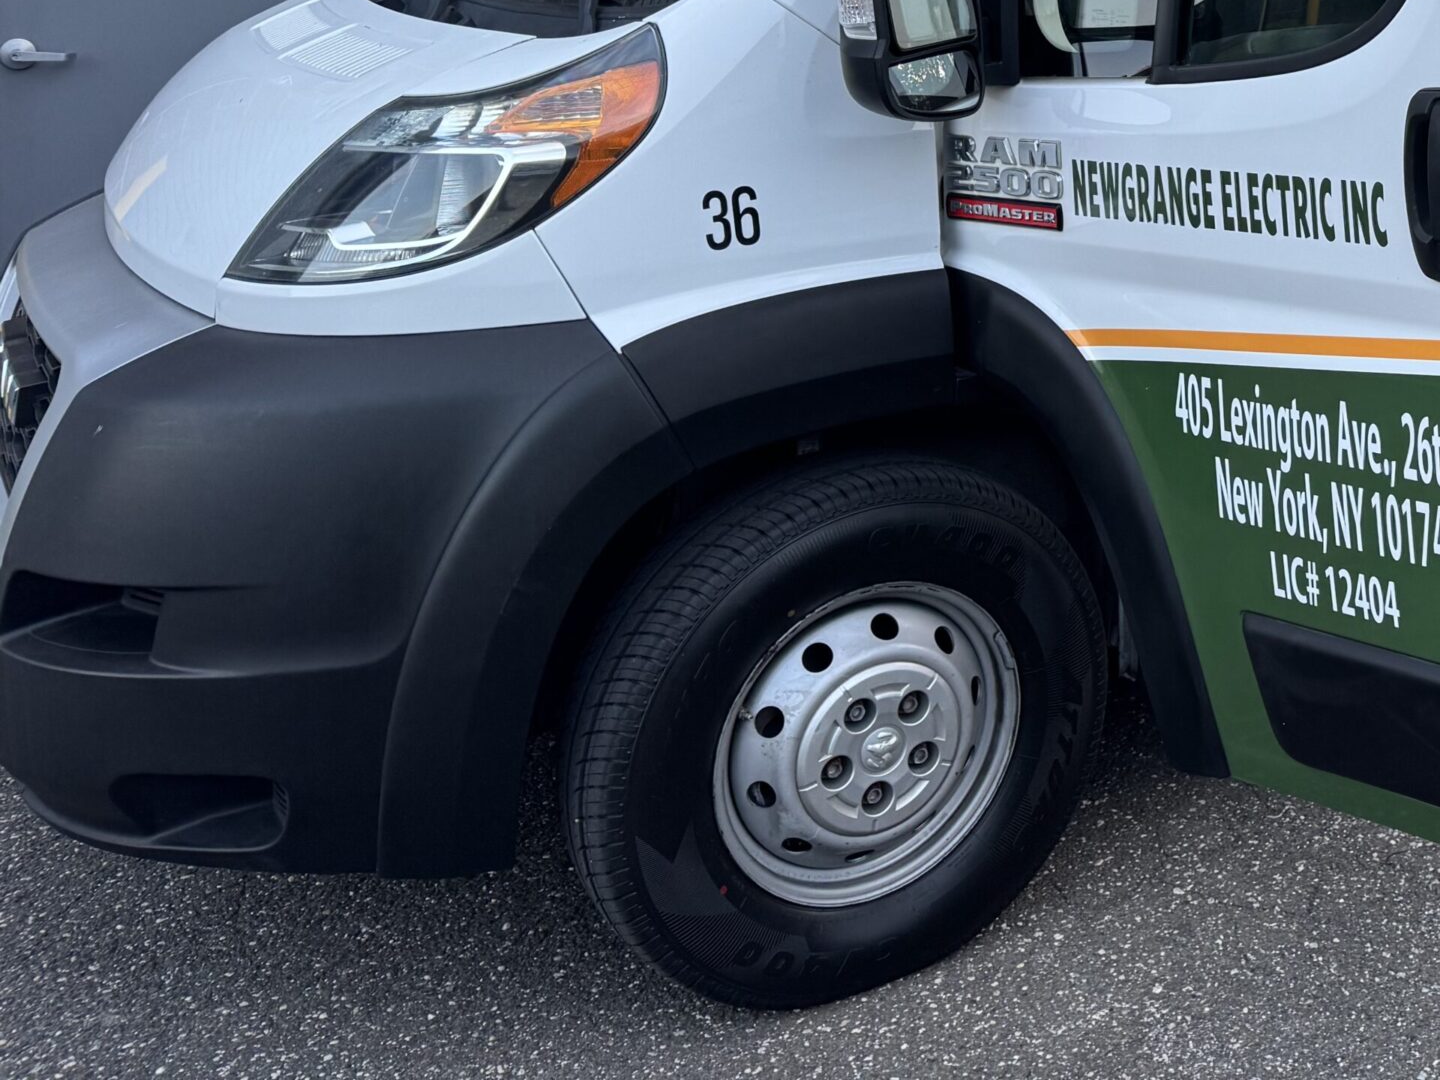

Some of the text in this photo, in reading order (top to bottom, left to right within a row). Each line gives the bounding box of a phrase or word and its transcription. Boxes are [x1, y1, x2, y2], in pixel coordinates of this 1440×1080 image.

[948, 134, 1062, 170] RAM
[948, 164, 1064, 200] 2500
[702, 185, 761, 250] 36
[1071, 159, 1388, 247] NEWGRANGE ELECTRIC INC
[1175, 373, 1213, 439] 405
[1217, 378, 1331, 473] Lexington
[1337, 400, 1396, 488] Ave.,
[1215, 456, 1263, 528] New
[1266, 467, 1328, 554] York,
[1330, 481, 1364, 552] NY
[1269, 551, 1400, 628] LIC# 12404
